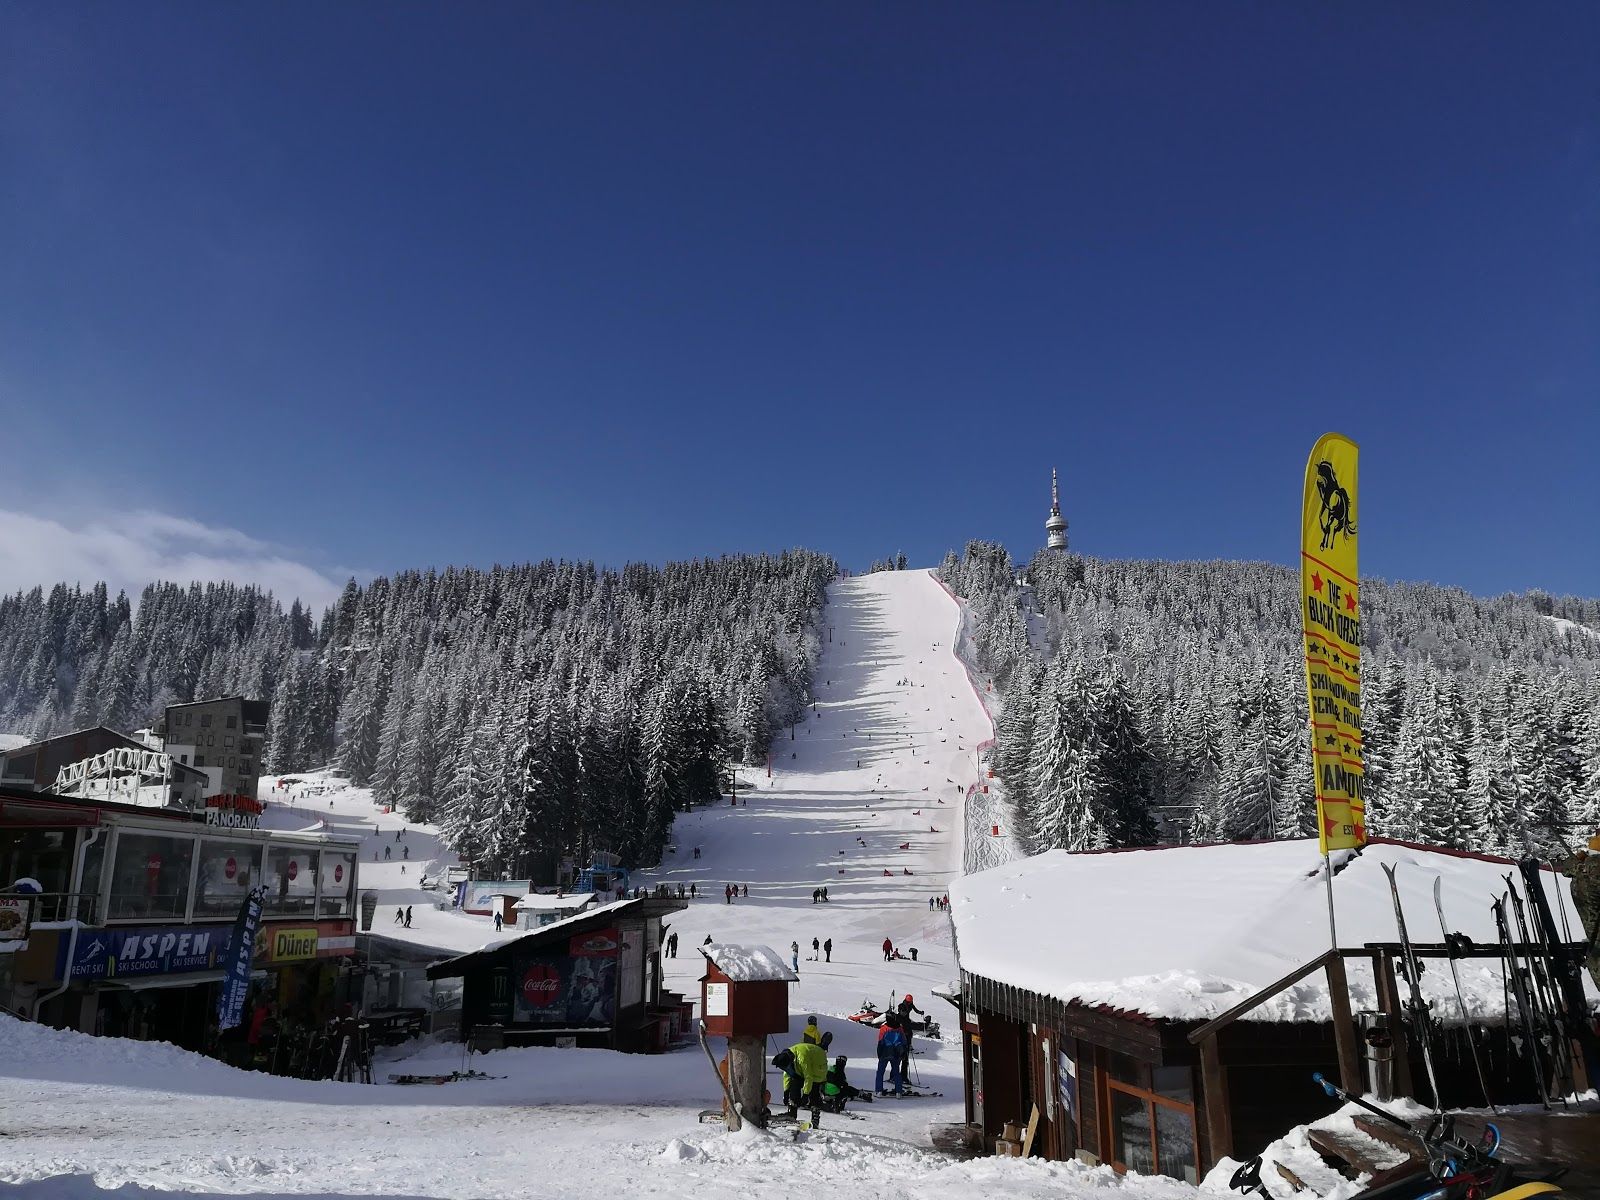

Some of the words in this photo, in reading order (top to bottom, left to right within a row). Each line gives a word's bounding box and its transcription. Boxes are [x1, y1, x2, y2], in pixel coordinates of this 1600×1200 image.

[1326, 578, 1341, 610] THE
[1310, 672, 1329, 690] SKI
[206, 810, 261, 830] PANORAMA
[119, 932, 210, 960] ASPEN
[236, 900, 261, 977] ASPEN
[276, 934, 316, 957] Düner
[71, 966, 91, 976] RENT
[92, 964, 104, 974] SKI
[118, 962, 129, 972] SKI
[129, 960, 159, 971] SCHOOL
[172, 957, 183, 967] SKI
[183, 956, 208, 966] SERVICE
[524, 978, 559, 991] Coca-Cola
